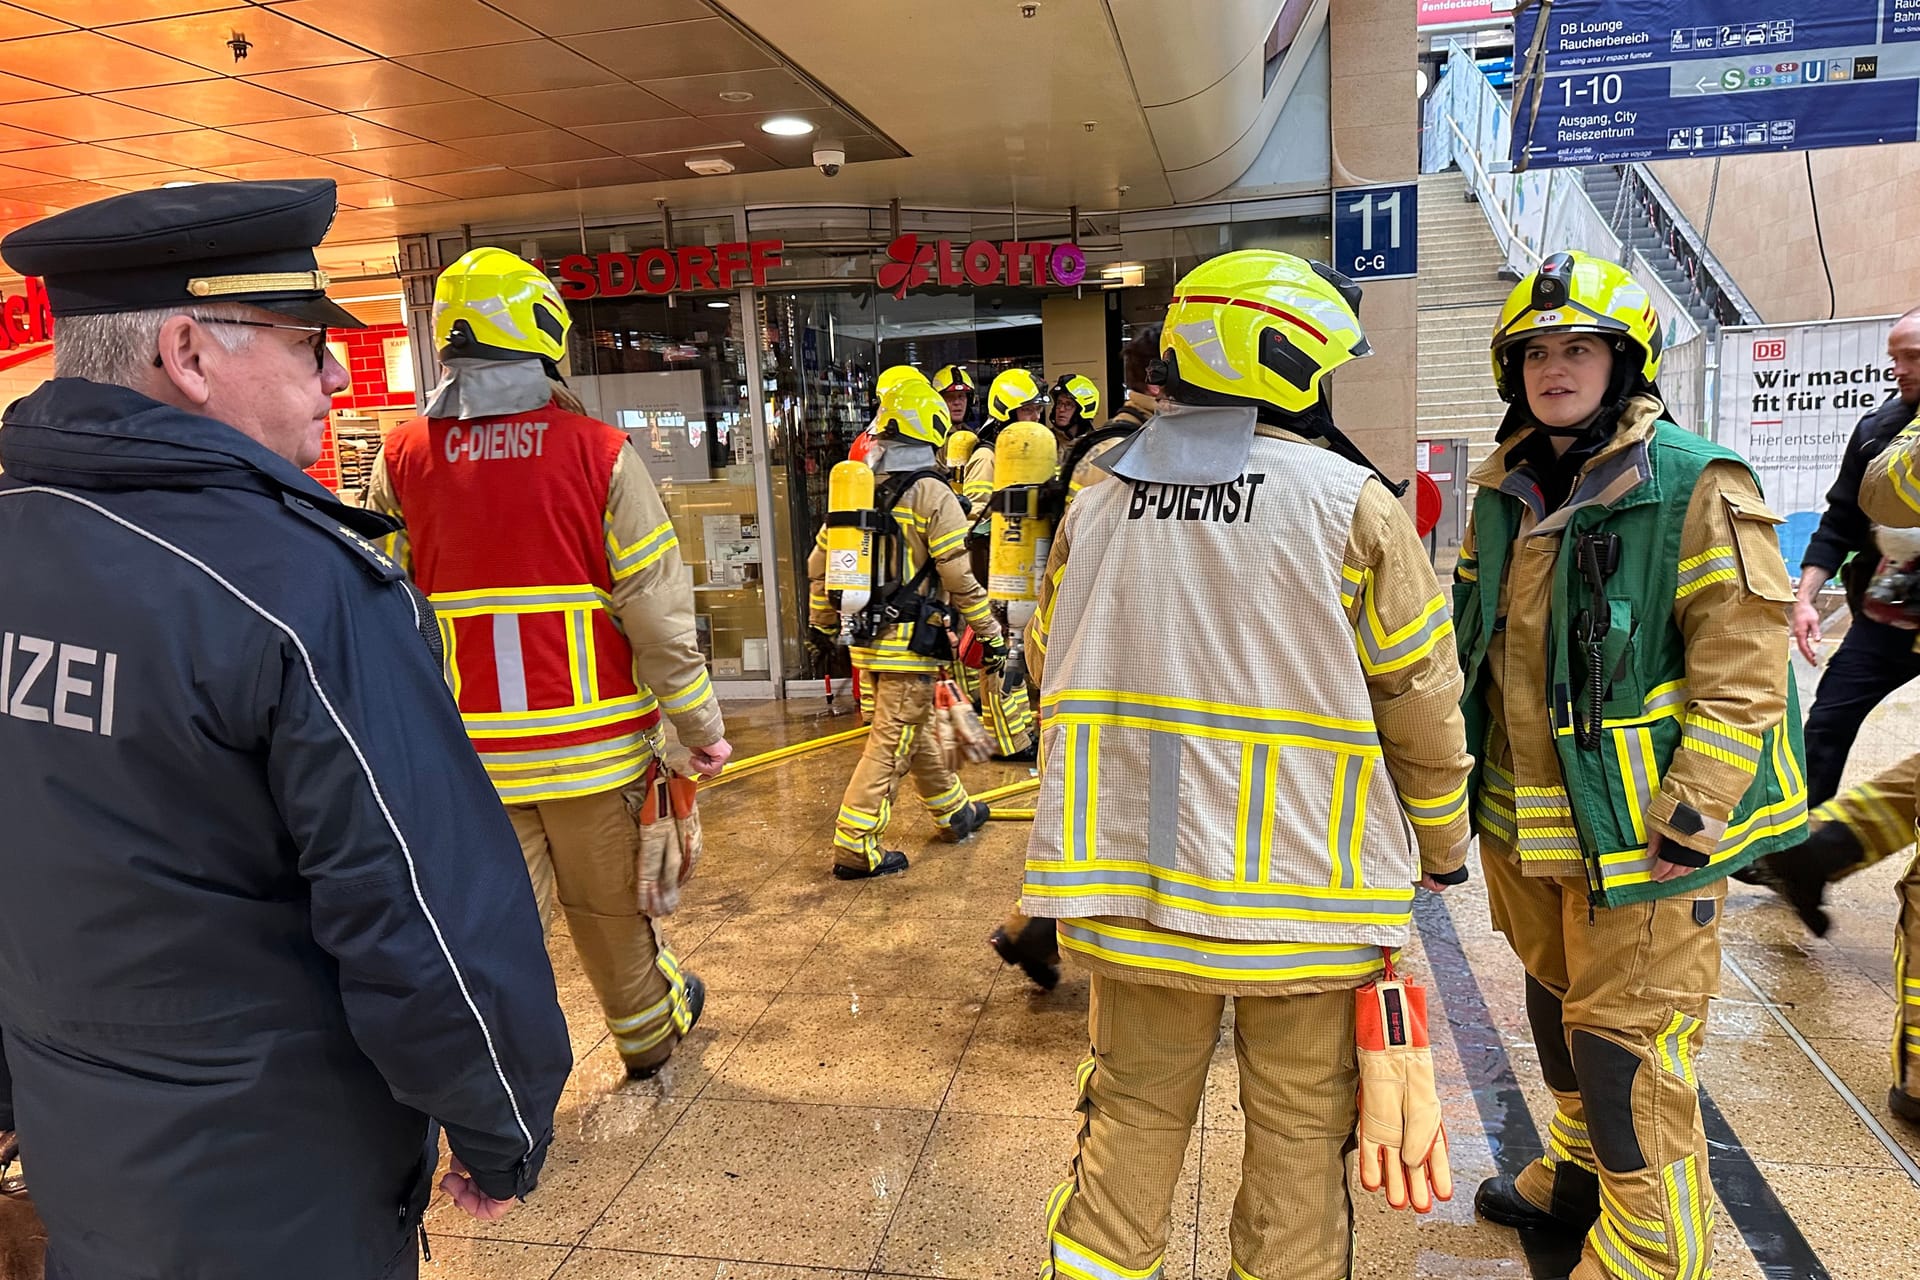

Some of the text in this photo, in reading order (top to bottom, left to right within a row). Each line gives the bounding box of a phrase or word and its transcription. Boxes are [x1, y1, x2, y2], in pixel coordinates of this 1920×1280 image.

[1560, 20, 1623, 35] DB Lounge
[1560, 31, 1649, 50] Raucherbereich
[1696, 38, 1713, 48] WC
[1755, 63, 1793, 74] S1 S4
[1805, 62, 1821, 82] U
[1856, 63, 1875, 73] TAXI
[1559, 73, 1623, 107] 1-10
[1754, 78, 1766, 86] S2
[1558, 110, 1638, 128] Ausgang, City
[1558, 127, 1634, 142] Reisezentrum
[1349, 191, 1401, 251] 11
[534, 240, 784, 300] SDORFF
[937, 239, 1087, 287] LOTTO
[1354, 254, 1385, 272] C-G
[1757, 343, 1782, 358] DB
[1753, 363, 1897, 388] Wir mache
[1752, 393, 1780, 412] fit
[1786, 390, 1826, 411] für
[1832, 388, 1875, 409] die
[444, 422, 549, 463] C-DIENST
[1750, 431, 1848, 446] Hier entsteht
[1128, 473, 1266, 524] B-DIENST
[0, 631, 118, 737] IZEI
